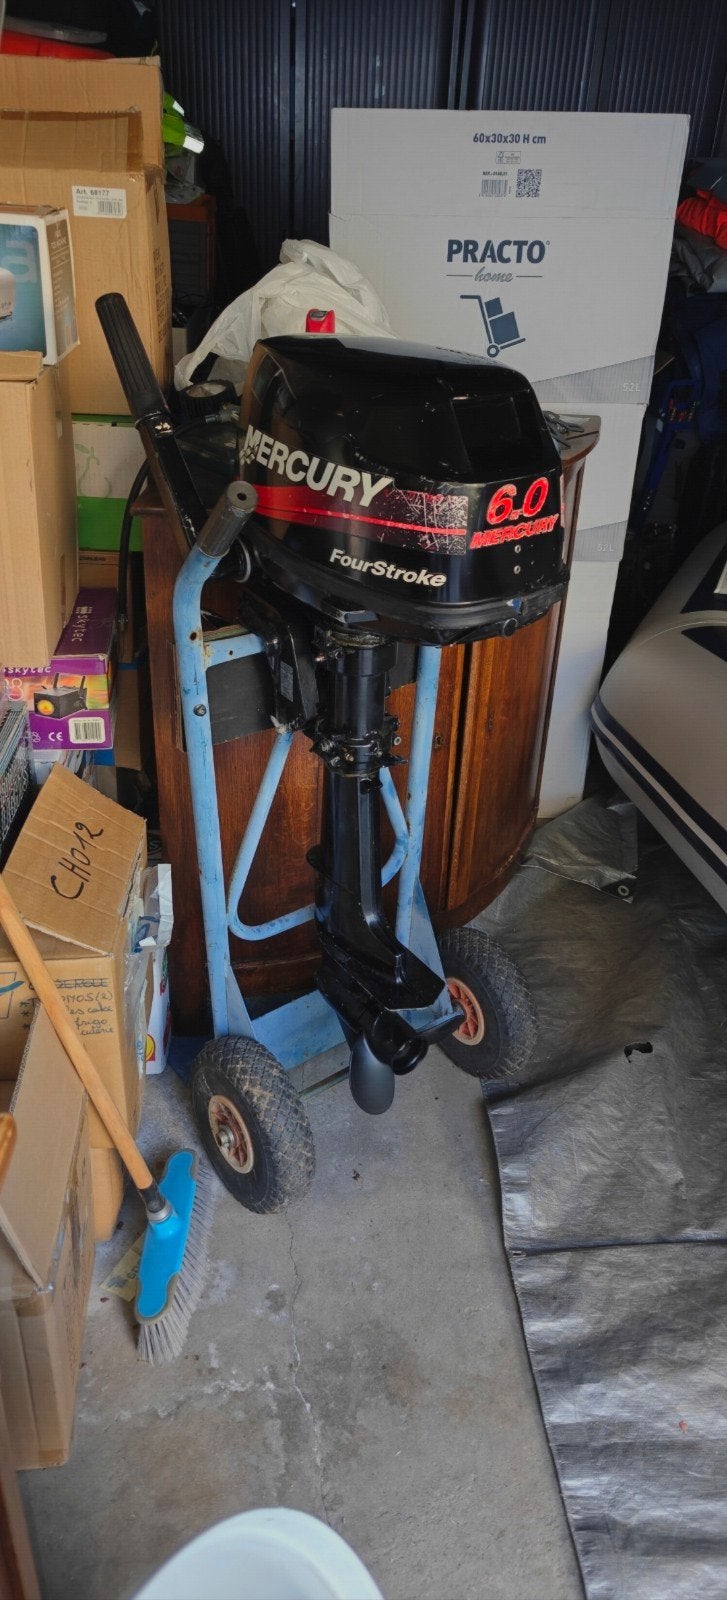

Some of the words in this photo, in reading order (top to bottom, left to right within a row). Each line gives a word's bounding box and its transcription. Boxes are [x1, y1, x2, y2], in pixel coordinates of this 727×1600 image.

[473, 133, 520, 144] 60x30x30
[522, 134, 530, 144] H
[532, 135, 547, 144] cm
[446, 239, 546, 264] PRACTO
[474, 266, 515, 283] home
[239, 424, 395, 508] MERCURY
[486, 476, 549, 525] 6.0
[470, 513, 560, 549] MERCURY
[329, 548, 447, 587] FourStroke
[71, 615, 88, 642] skytec
[8, 666, 52, 676] skytec
